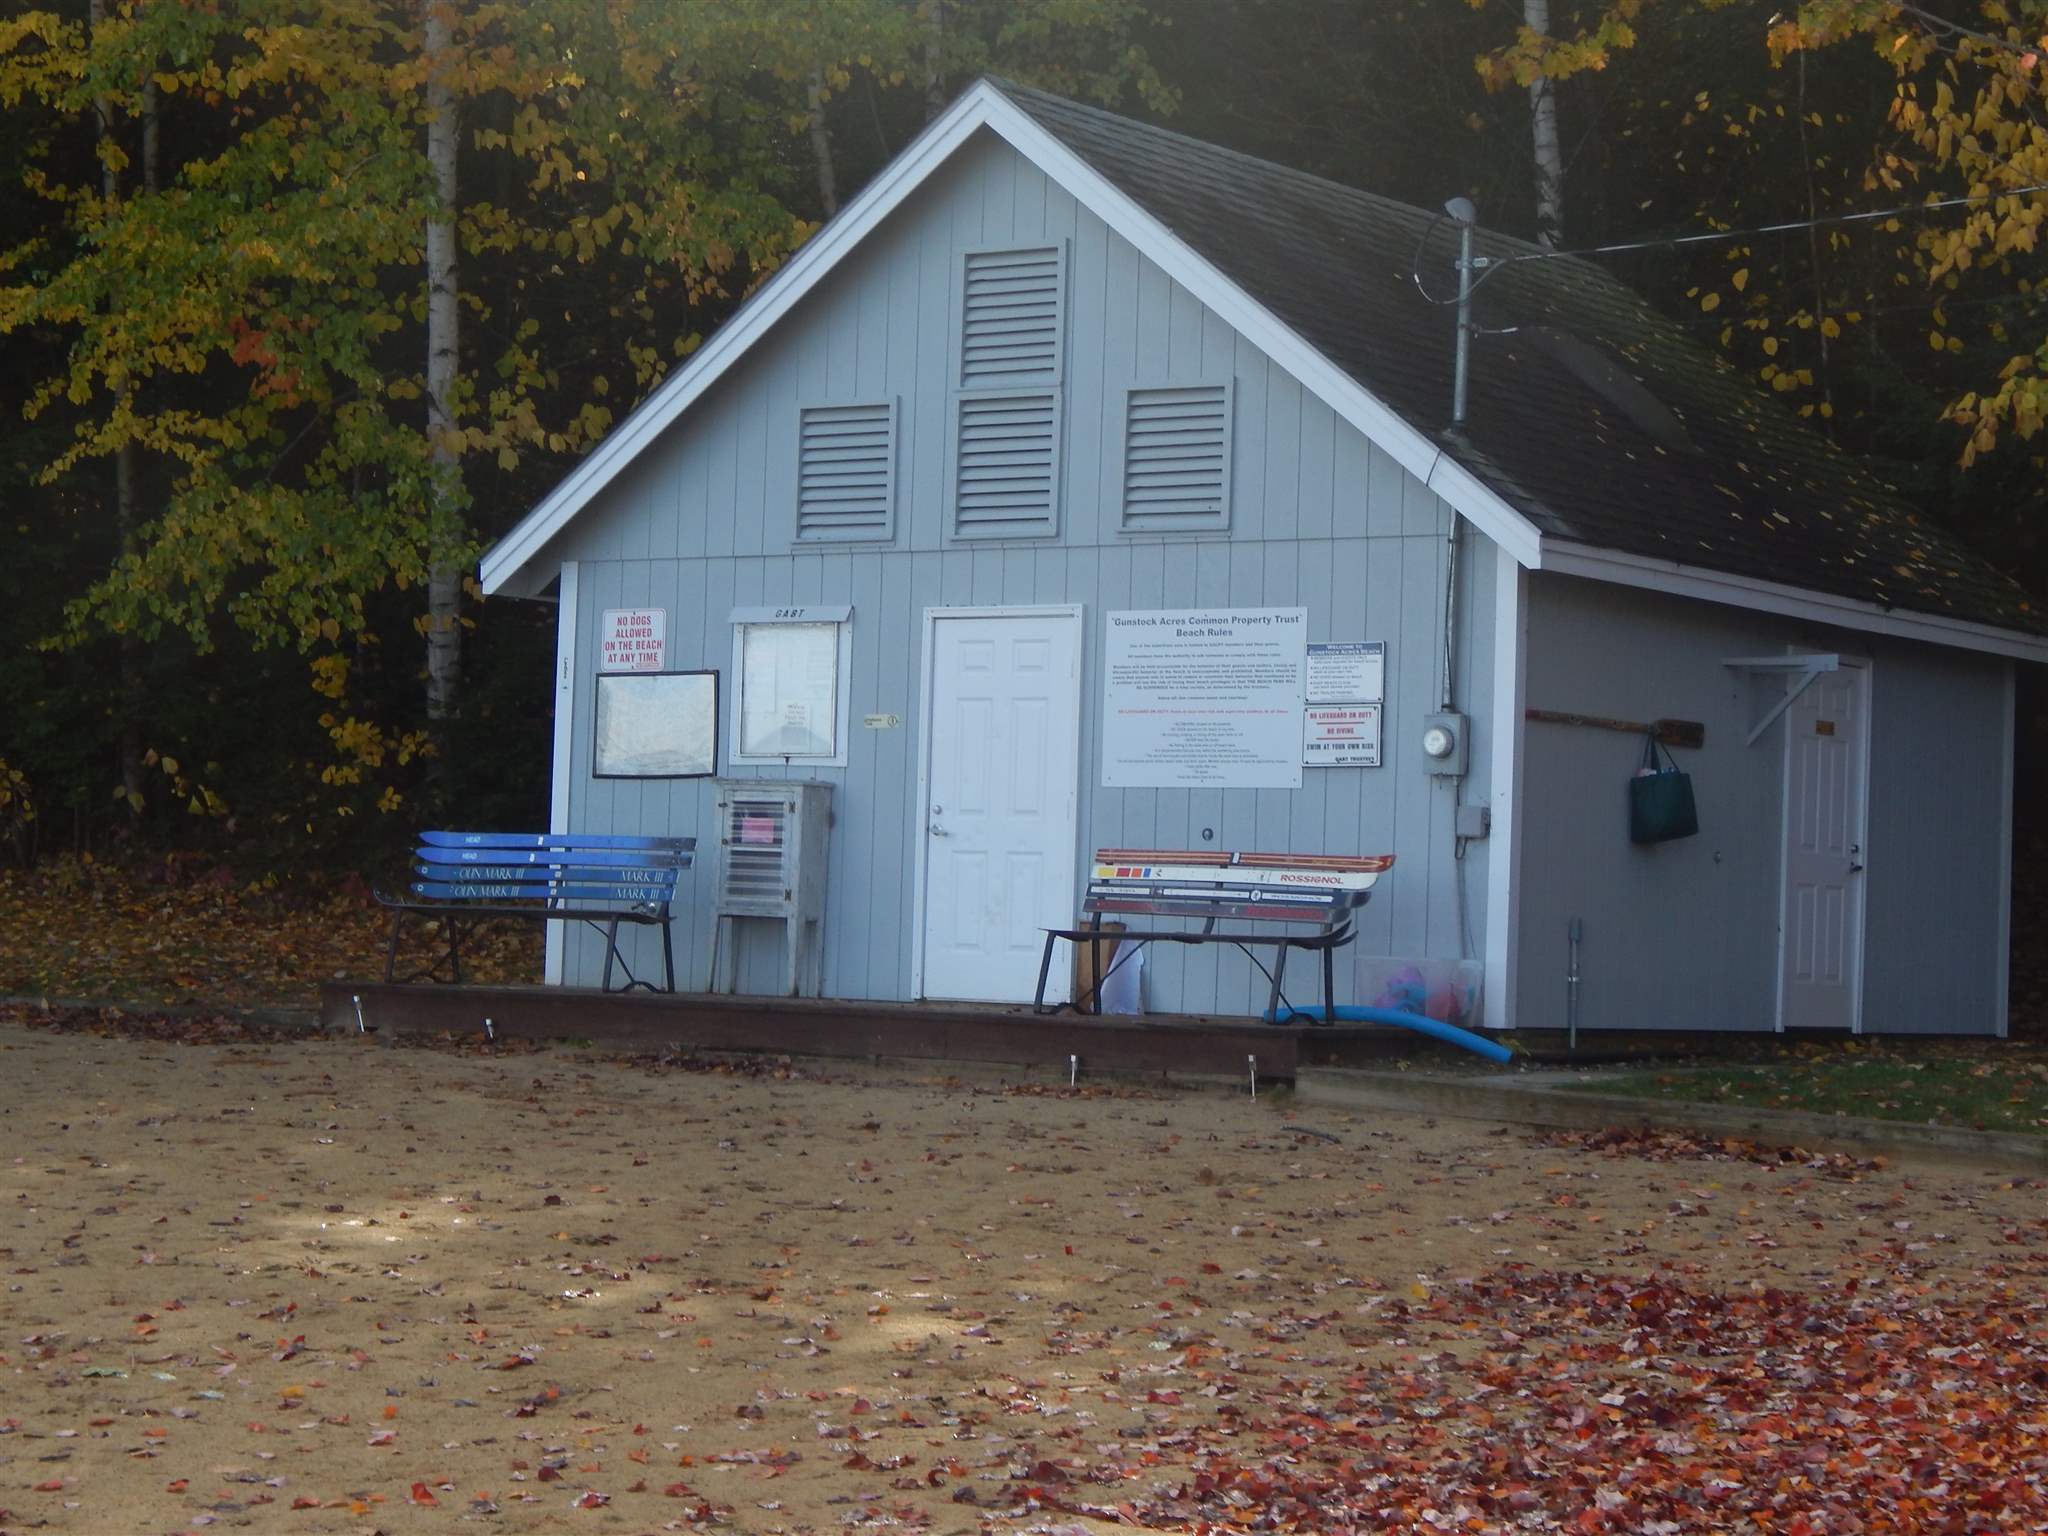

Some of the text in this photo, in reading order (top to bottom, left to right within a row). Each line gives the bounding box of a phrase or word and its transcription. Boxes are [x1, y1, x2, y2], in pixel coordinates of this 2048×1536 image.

[617, 616, 652, 626] NO DOGS
[1114, 615, 1299, 626] Gunstock Acres Common Property Trust
[616, 628, 652, 638] ALLOWED
[1176, 628, 1232, 637] Beach Rules
[605, 640, 662, 651] ON THE BEACH
[608, 653, 658, 663] AT ANY TIME
[485, 869, 512, 880] MARK
[515, 869, 525, 879] III
[622, 871, 649, 882] MARK
[1280, 874, 1344, 885] ROSSIGNOL
[480, 886, 507, 897] MARK
[510, 886, 520, 896] III
[615, 888, 646, 900] MARK
